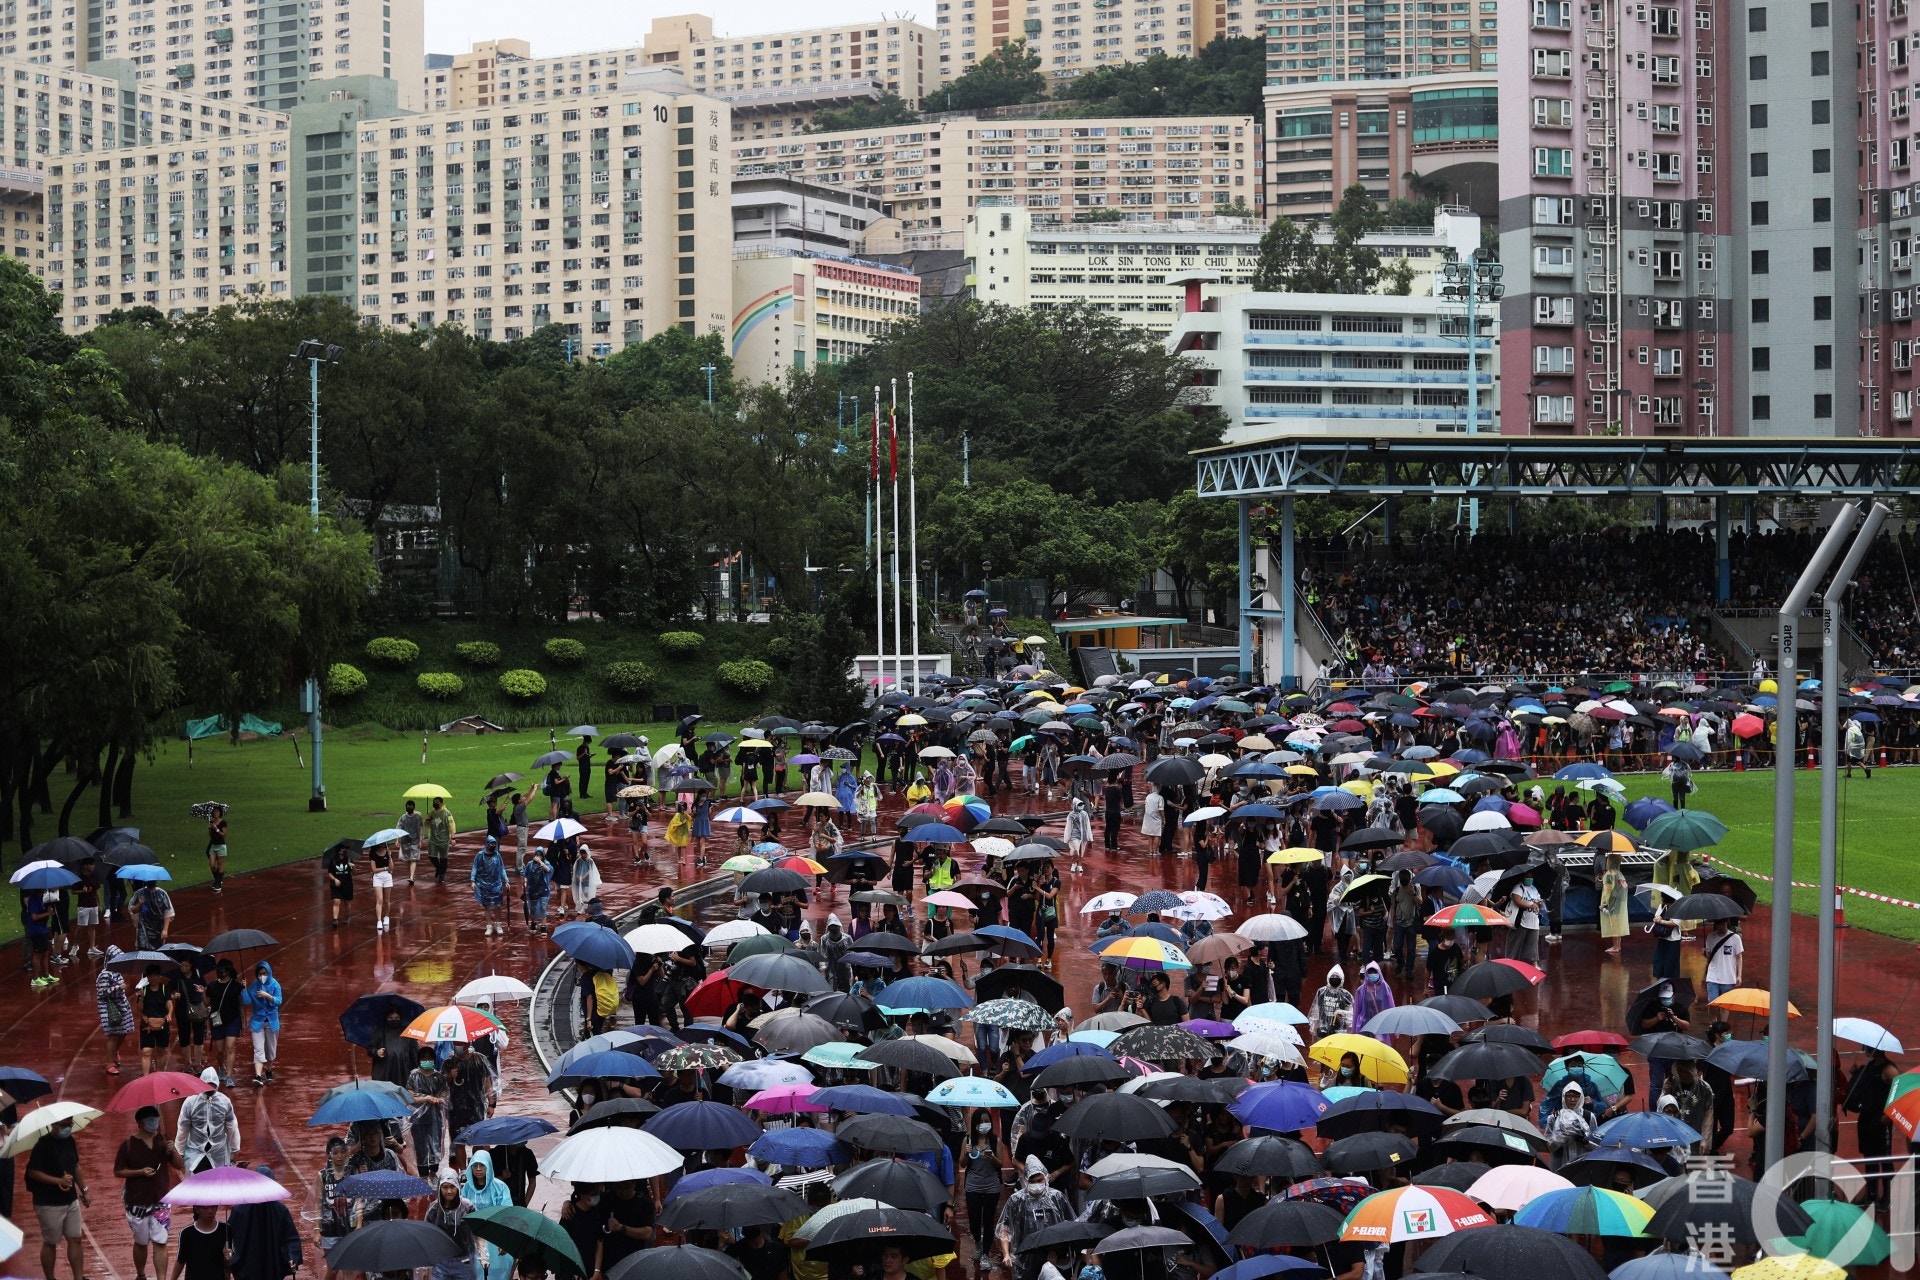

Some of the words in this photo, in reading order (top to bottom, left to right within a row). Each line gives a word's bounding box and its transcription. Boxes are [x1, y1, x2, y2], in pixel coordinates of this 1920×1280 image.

[909, 30, 914, 42] 6
[909, 98, 915, 110] 6
[285, 114, 290, 122] 9
[652, 104, 668, 123] 10
[941, 122, 947, 131] 7
[1243, 118, 1252, 127] 7
[709, 109, 720, 198] 葵盛西邨
[1088, 256, 1109, 266] LOK
[1118, 256, 1134, 266] SIN
[1143, 257, 1171, 266] TONG
[1180, 257, 1195, 267] KU
[1204, 257, 1228, 267] CHIU
[1237, 257, 1260, 267] MAN
[710, 312, 726, 321] KWAI
[708, 323, 726, 333] SHING
[1823, 608, 1833, 634] artec
[1783, 624, 1794, 654] artec
